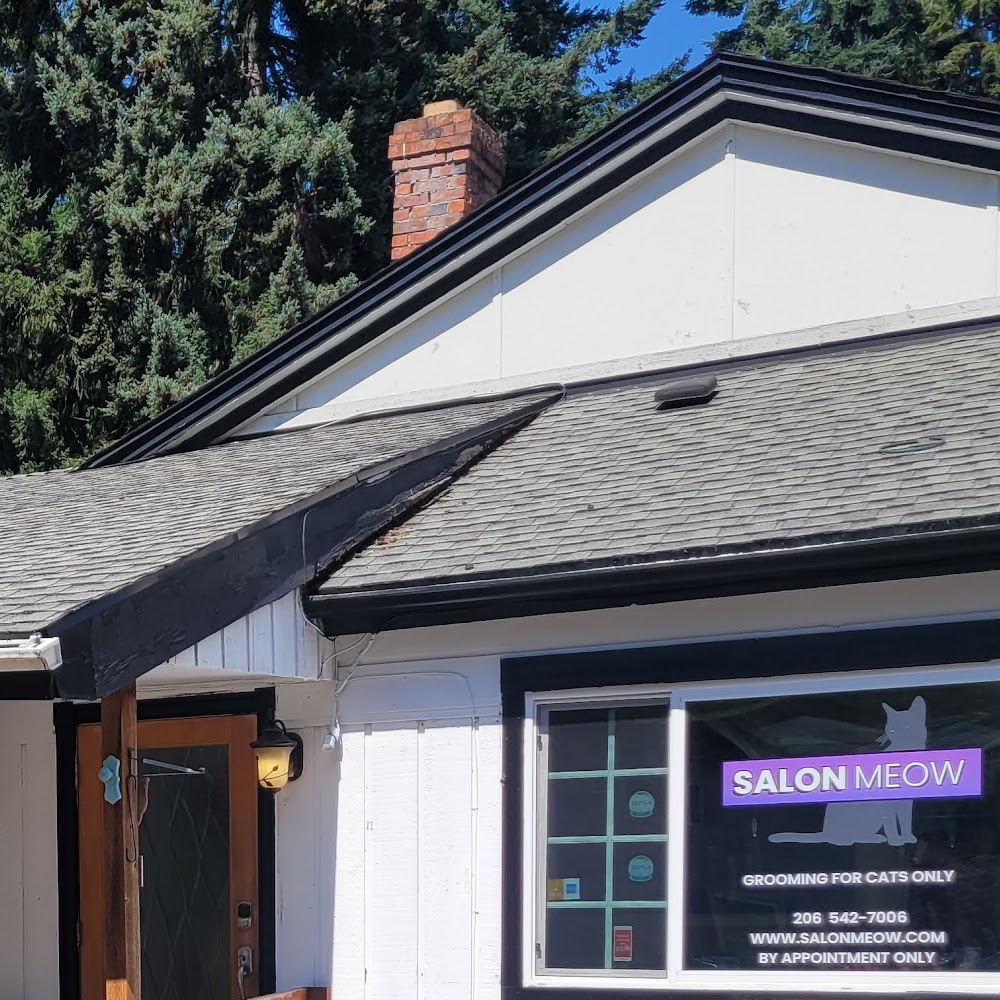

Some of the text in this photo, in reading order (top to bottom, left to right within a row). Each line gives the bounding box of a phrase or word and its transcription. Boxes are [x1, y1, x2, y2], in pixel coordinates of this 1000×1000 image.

[734, 759, 965, 795] SALON MEOW
[743, 870, 954, 886] GROOMING FOR CATS ONLY
[793, 911, 908, 925] 206 542-7006
[750, 931, 945, 944] WWW.SALONMEOW.COM
[759, 951, 936, 964] BY APPOINTMENT ONLY
